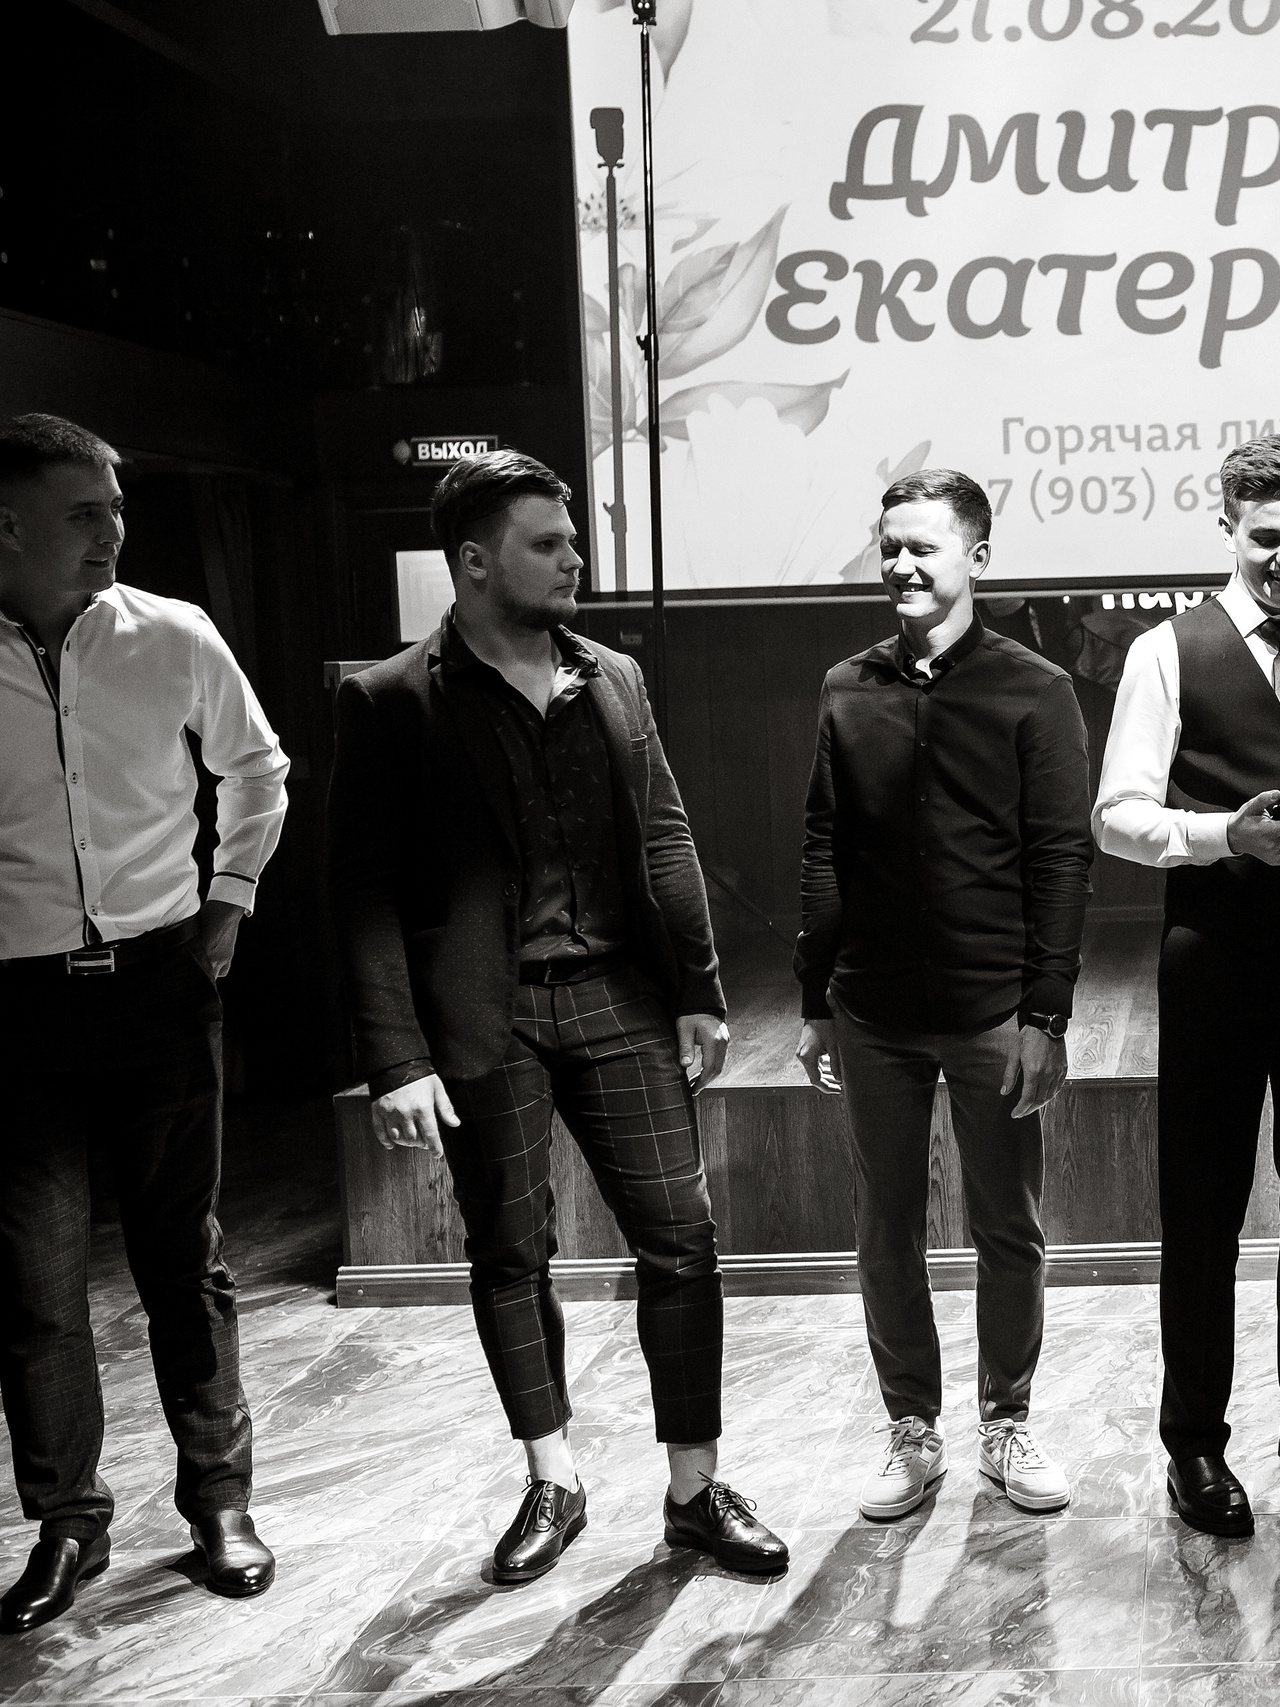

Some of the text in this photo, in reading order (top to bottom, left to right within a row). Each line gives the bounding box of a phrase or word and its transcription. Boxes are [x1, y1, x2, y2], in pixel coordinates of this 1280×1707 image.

[417, 441, 488, 460] ВЫХОД
[1001, 416, 1202, 466] Горячая
[1029, 466, 1156, 524] (903)
